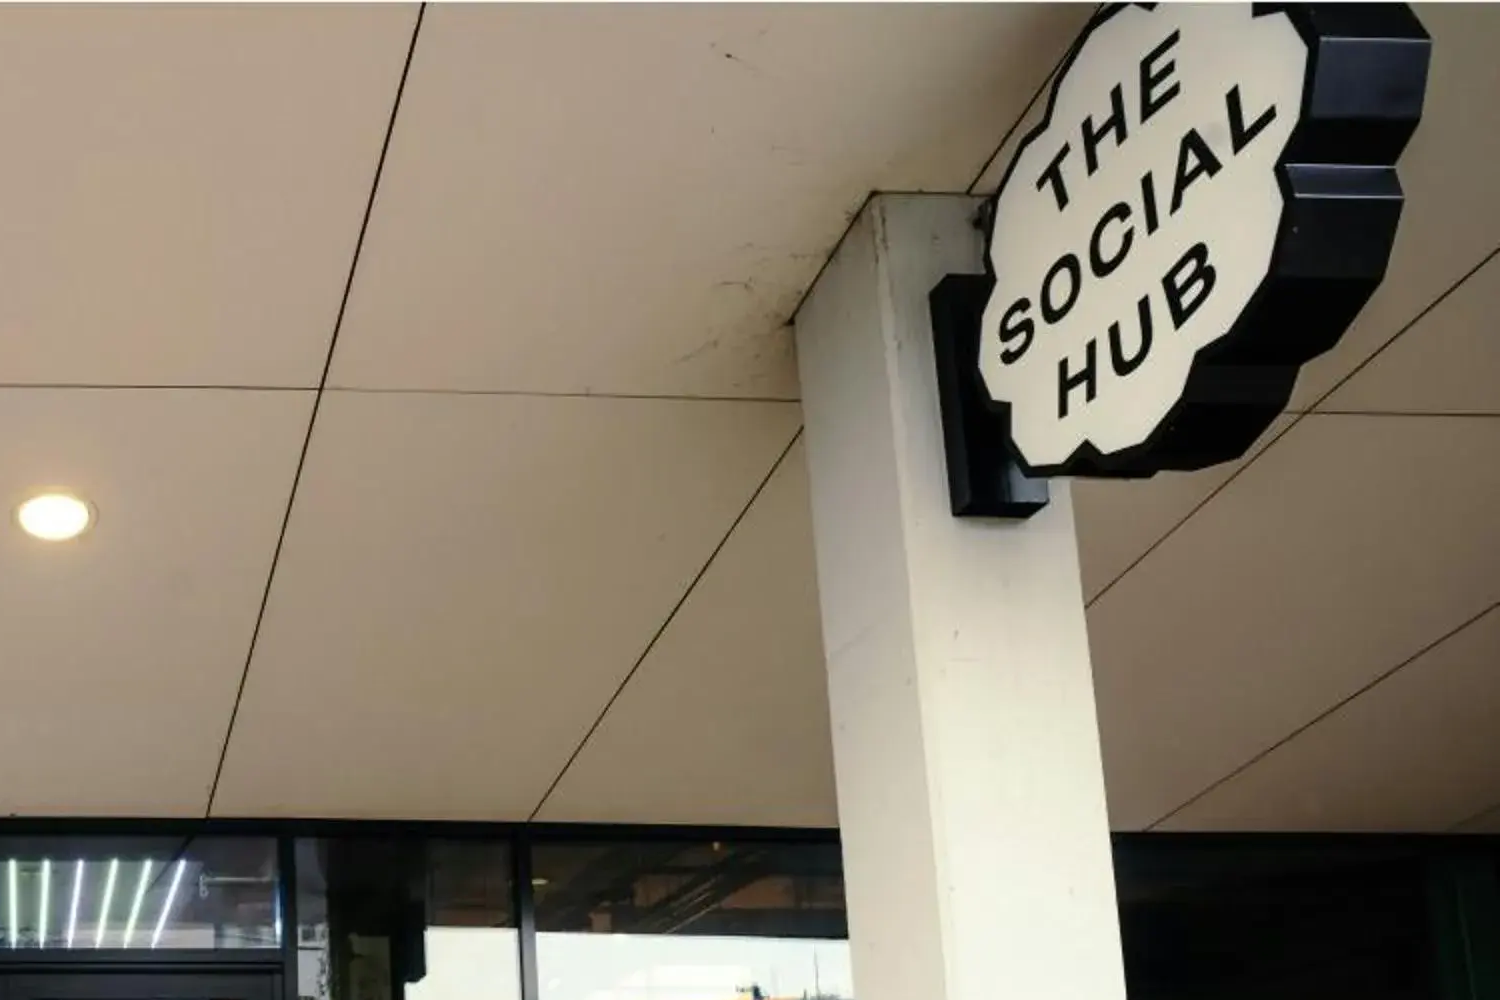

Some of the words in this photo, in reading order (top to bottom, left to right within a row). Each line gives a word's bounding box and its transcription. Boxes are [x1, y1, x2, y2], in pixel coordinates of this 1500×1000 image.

[1036, 29, 1181, 212] THE
[999, 84, 1277, 365] SOCIAL
[1058, 242, 1217, 419] HUB
